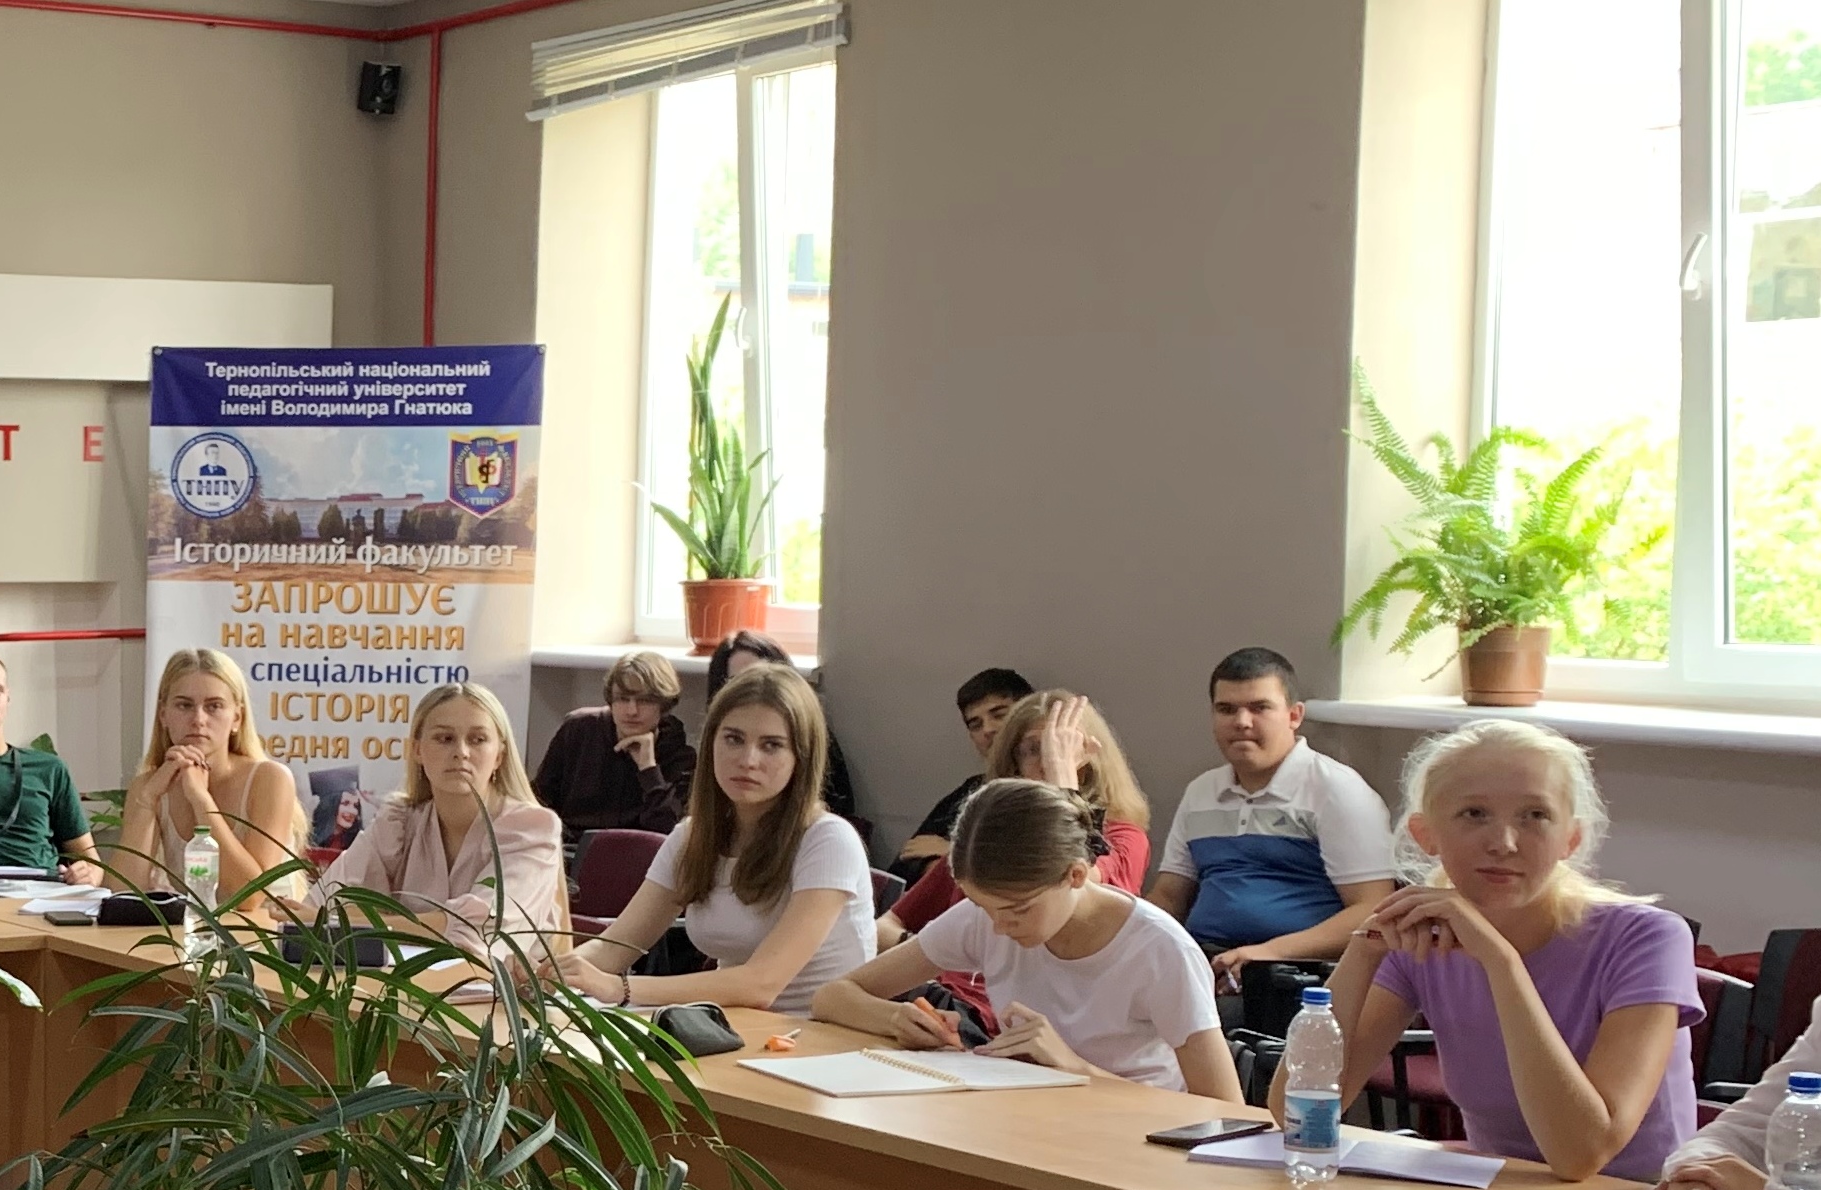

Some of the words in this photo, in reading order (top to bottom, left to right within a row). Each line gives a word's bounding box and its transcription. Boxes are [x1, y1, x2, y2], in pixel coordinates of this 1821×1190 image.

[205, 361, 354, 380] Тернопільський
[359, 360, 491, 380] національний
[227, 381, 349, 399] педагогічний
[353, 382, 467, 400] університет
[221, 400, 266, 416] імені
[271, 400, 389, 419] Володимира
[394, 400, 473, 417] Гнатюка
[182, 479, 245, 501] ТНПУ
[174, 537, 347, 570] Історичний
[356, 536, 518, 574] факультет
[230, 580, 457, 616] ЗАПРОШУЄ
[221, 622, 266, 648] на
[279, 624, 466, 651] навчання
[250, 656, 470, 688] спеціальністю
[268, 691, 411, 724] ІСТОРІЯ
